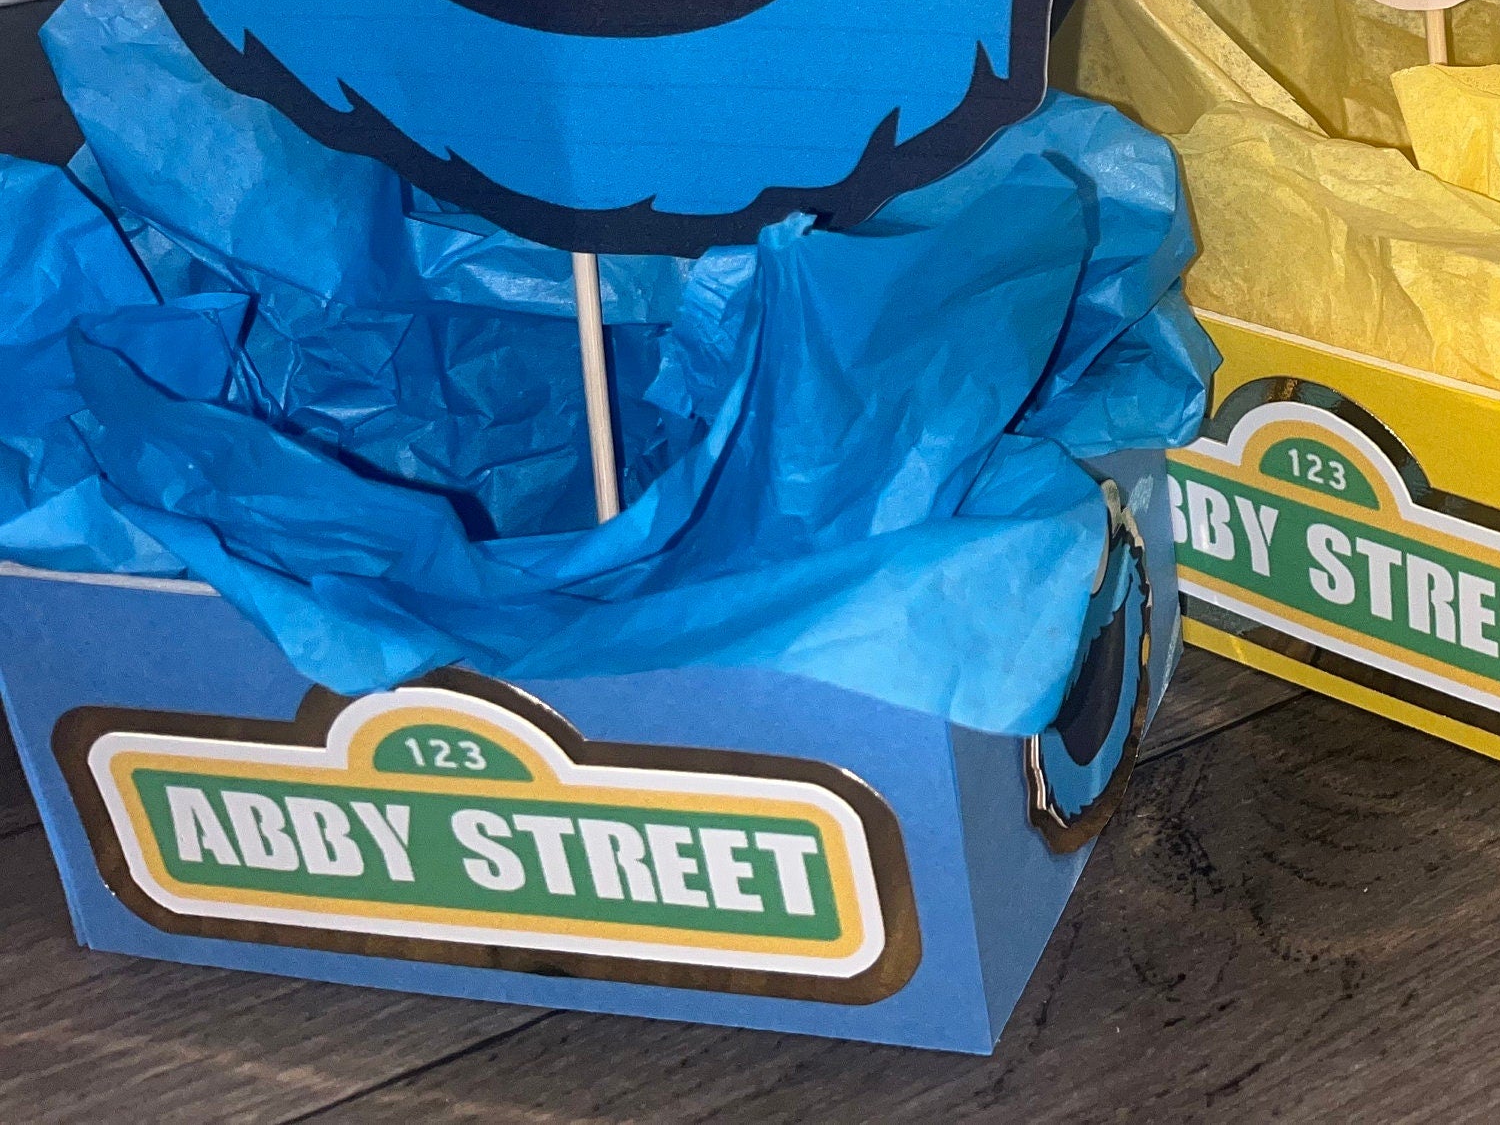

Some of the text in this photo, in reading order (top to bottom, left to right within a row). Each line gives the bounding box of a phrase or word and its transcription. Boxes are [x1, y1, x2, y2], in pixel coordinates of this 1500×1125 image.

[1287, 448, 1348, 492] 123
[404, 737, 488, 771] 123
[163, 784, 821, 918] ABBY STREET
